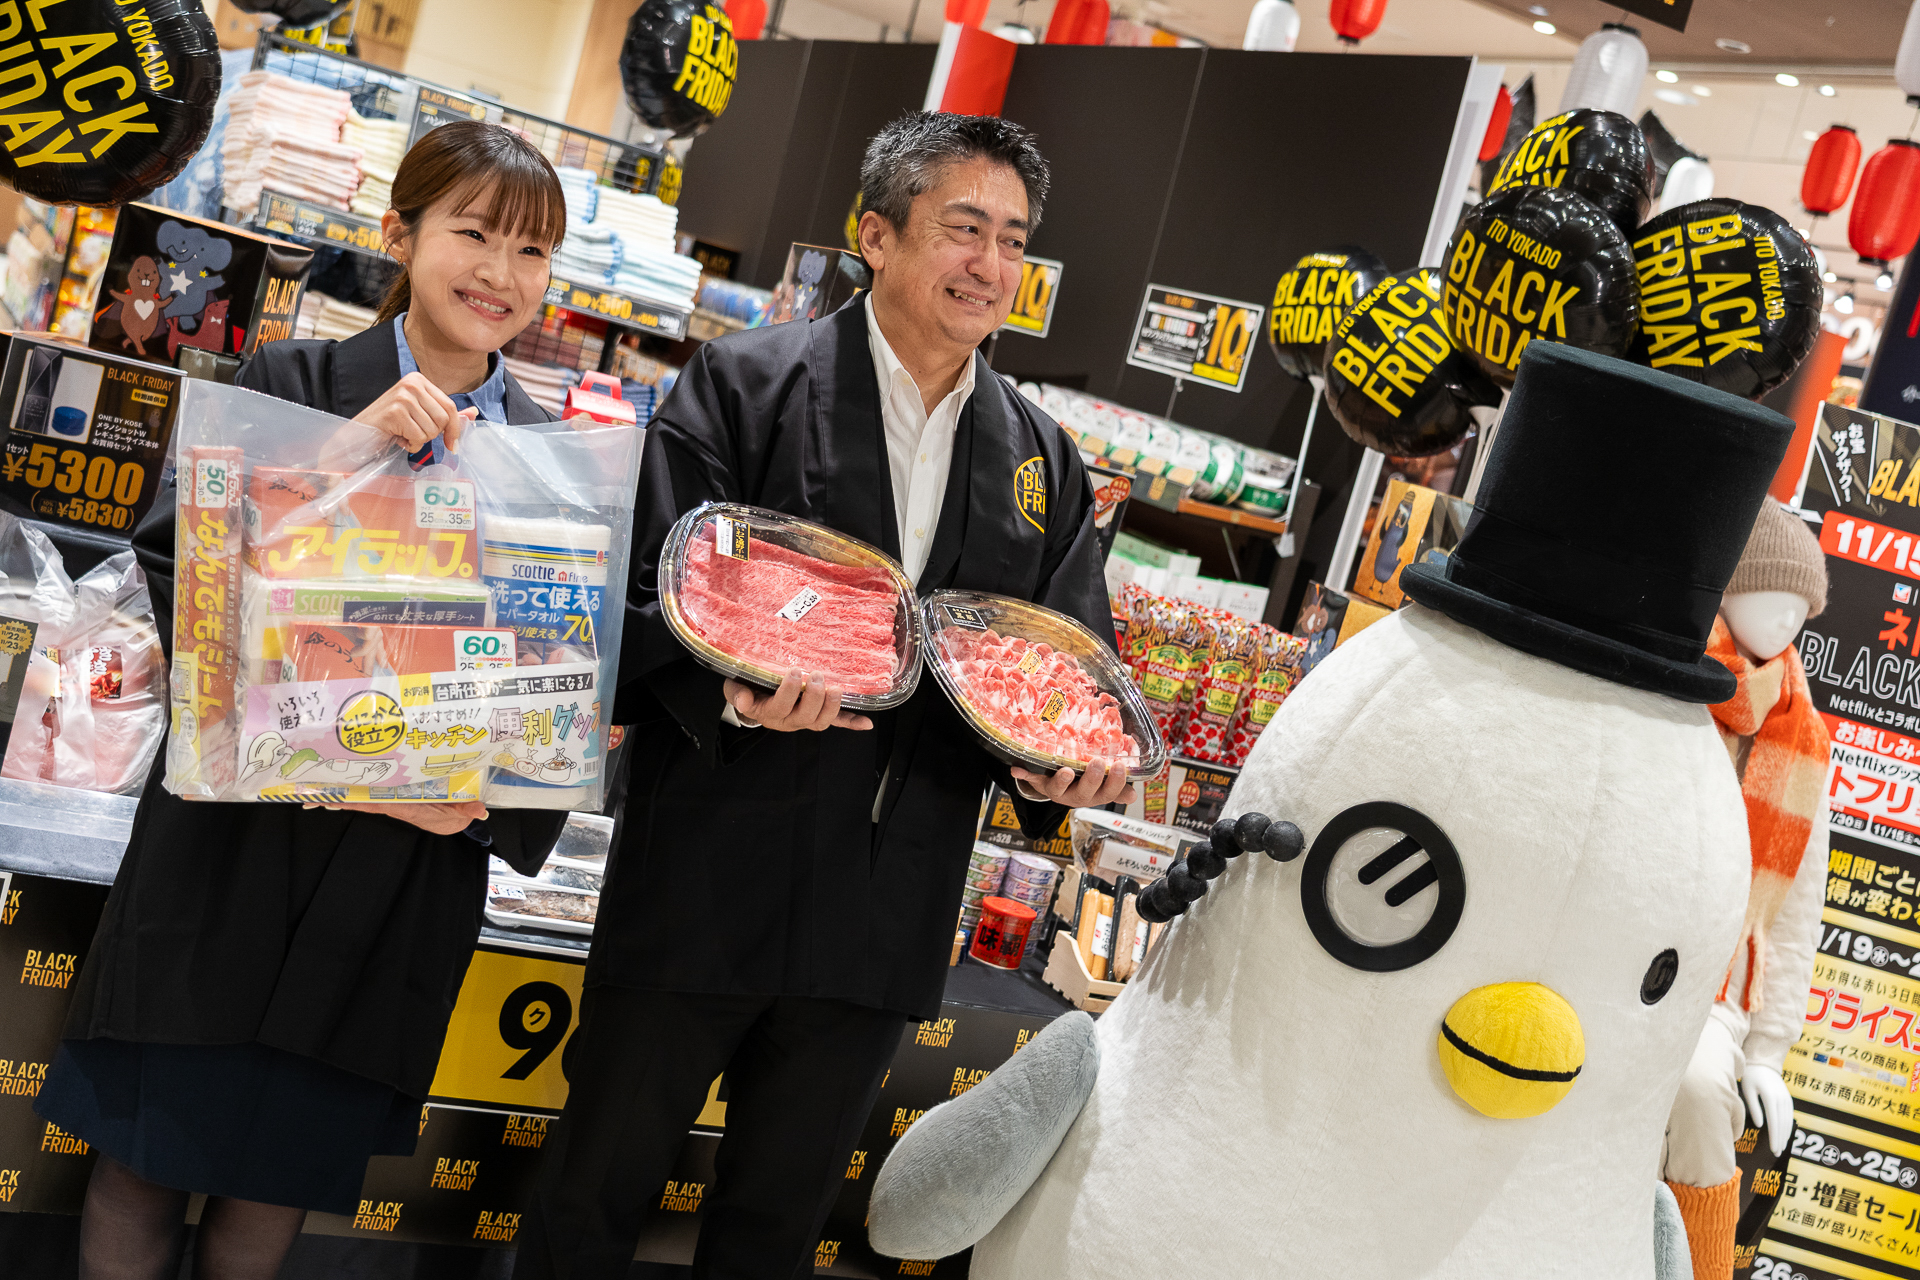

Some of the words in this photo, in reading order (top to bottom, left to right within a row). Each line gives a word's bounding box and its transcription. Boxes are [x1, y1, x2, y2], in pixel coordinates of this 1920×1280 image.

[122, 7, 175, 92] YOKADO
[1485, 217, 1509, 244] ITO
[1506, 228, 1562, 271] YOKADO
[1753, 235, 1776, 259] ITO
[1272, 267, 1361, 307] BLACK
[1448, 229, 1581, 339] BLACK
[1686, 213, 1764, 367] BLACK
[1758, 262, 1786, 321] YOKADO
[262, 277, 302, 316] BLACK
[1336, 315, 1356, 339] ITO
[1352, 275, 1399, 318] YOKADO
[1633, 224, 1705, 369] FRIDAY
[253, 318, 293, 355] FRIDAY
[1331, 268, 1442, 388] BLACK
[1443, 280, 1546, 372] FRIDA
[107, 367, 140, 385] BLACK
[142, 375, 175, 392] FRIDAY
[98, 413, 113, 423] ONE
[113, 416, 124, 424] BY
[124, 419, 144, 429] KOSE
[6, 442, 29, 455] 1セット
[1847, 422, 1867, 455] お宝
[1, 442, 146, 506] ¥5300
[206, 464, 227, 496] 50
[1868, 457, 1920, 508] BLA
[423, 485, 460, 506] 60
[492, 580, 601, 611] 洗って使える
[193, 510, 229, 719] なんでもシート
[495, 607, 561, 623] ーパータオル
[463, 635, 501, 656] 60
[277, 690, 320, 713] いろいろ
[339, 704, 404, 733] とにかく
[346, 725, 401, 749] 役立つ
[406, 724, 488, 750] キッチン
[1834, 720, 1920, 761] お楽しみ
[1187, 769, 1209, 781] BLACK
[1209, 773, 1231, 786] FRIDAY
[1828, 848, 1920, 898] 期間ごと
[24, 949, 78, 973] BLACK
[20, 966, 74, 989] FRIDAY
[498, 980, 573, 1081] 9
[914, 1030, 953, 1049] FRIDAY
[0, 1058, 50, 1081] BLACK
[506, 1114, 550, 1134] BLACK
[893, 1107, 928, 1124] BLAC
[40, 1135, 91, 1156] FRIDAY
[501, 1129, 546, 1149] FRIDAY
[435, 1156, 480, 1177] BLACK
[1753, 1167, 1783, 1185] BLACK
[430, 1172, 476, 1192] FRIDAY
[664, 1179, 706, 1199] BLACK
[1749, 1183, 1781, 1198] FRIDAY
[357, 1199, 404, 1218] BLACK
[659, 1194, 702, 1213] FRIDAY
[352, 1214, 400, 1233] FRIDAY
[477, 1209, 522, 1228] BLACK
[472, 1225, 518, 1242] FRIDAY
[897, 1260, 937, 1277] FRIDAY
